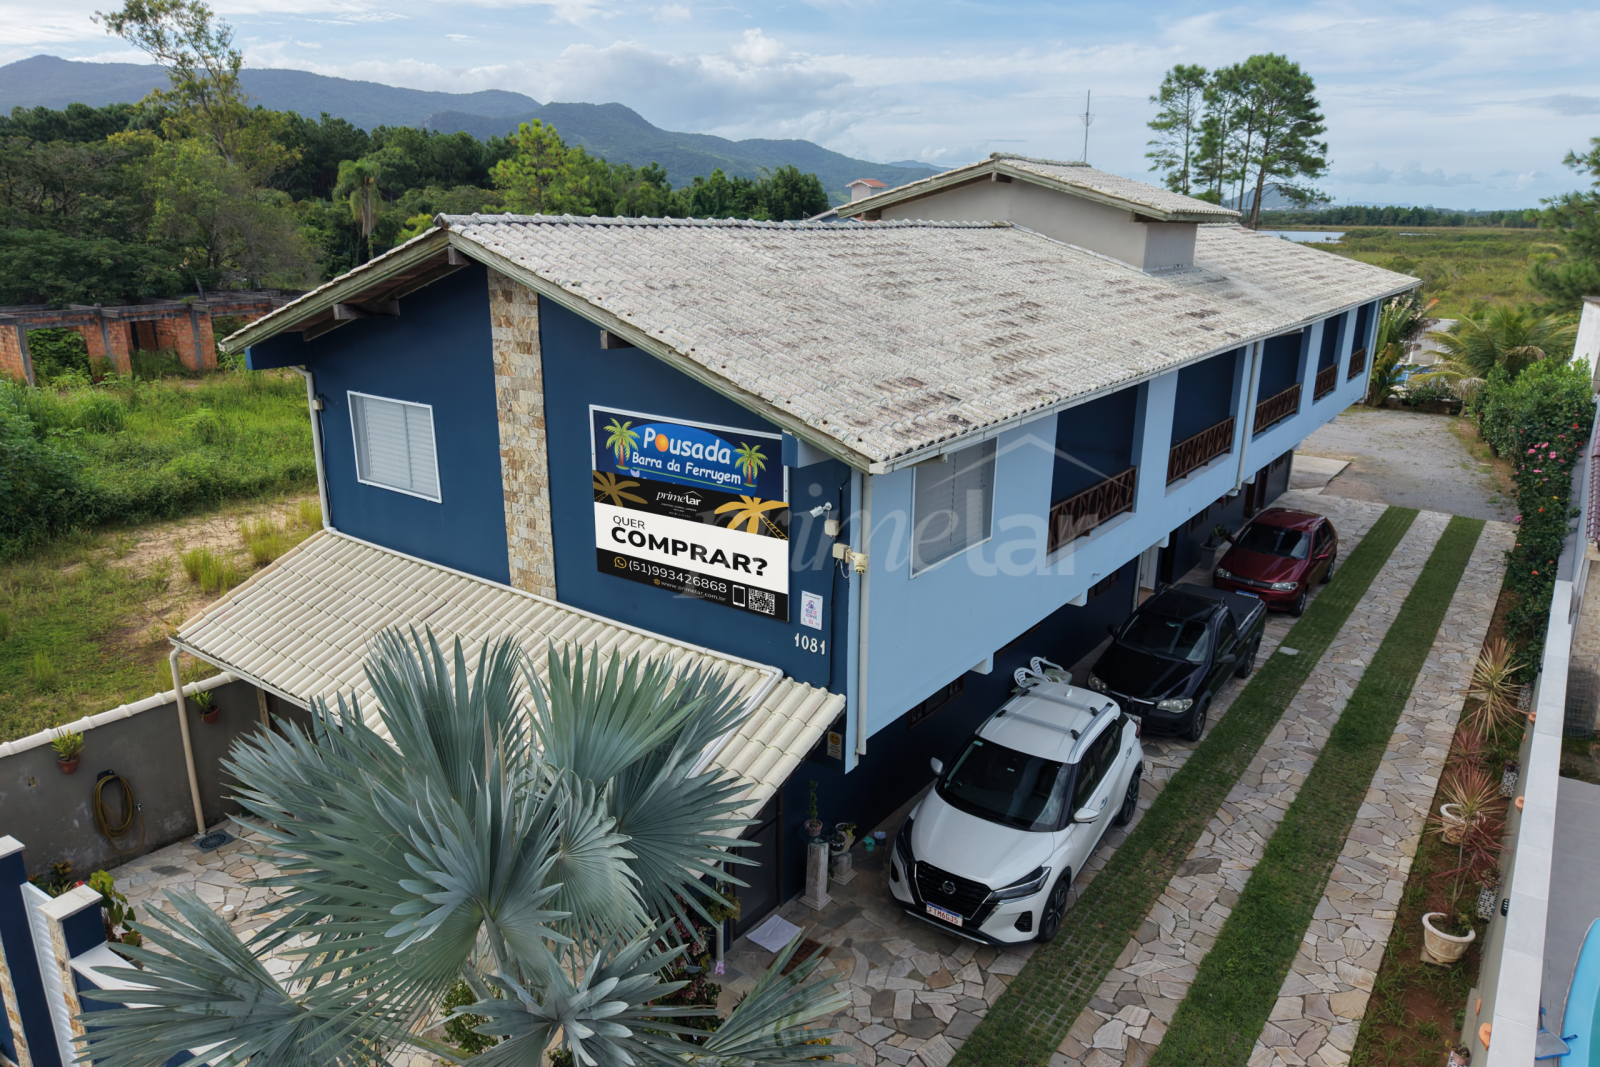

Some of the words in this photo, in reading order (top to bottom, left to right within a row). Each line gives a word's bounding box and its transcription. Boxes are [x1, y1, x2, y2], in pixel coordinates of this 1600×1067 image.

[643, 427, 731, 465] Pousada
[632, 451, 662, 469] Barra
[667, 459, 681, 473] da
[685, 462, 741, 485] Ferrugem
[655, 491, 702, 506] primelar
[613, 515, 646, 530] QUER
[611, 526, 768, 577] COMPRAR?
[628, 559, 728, 594] (51)993426868
[794, 632, 826, 655] 1081
